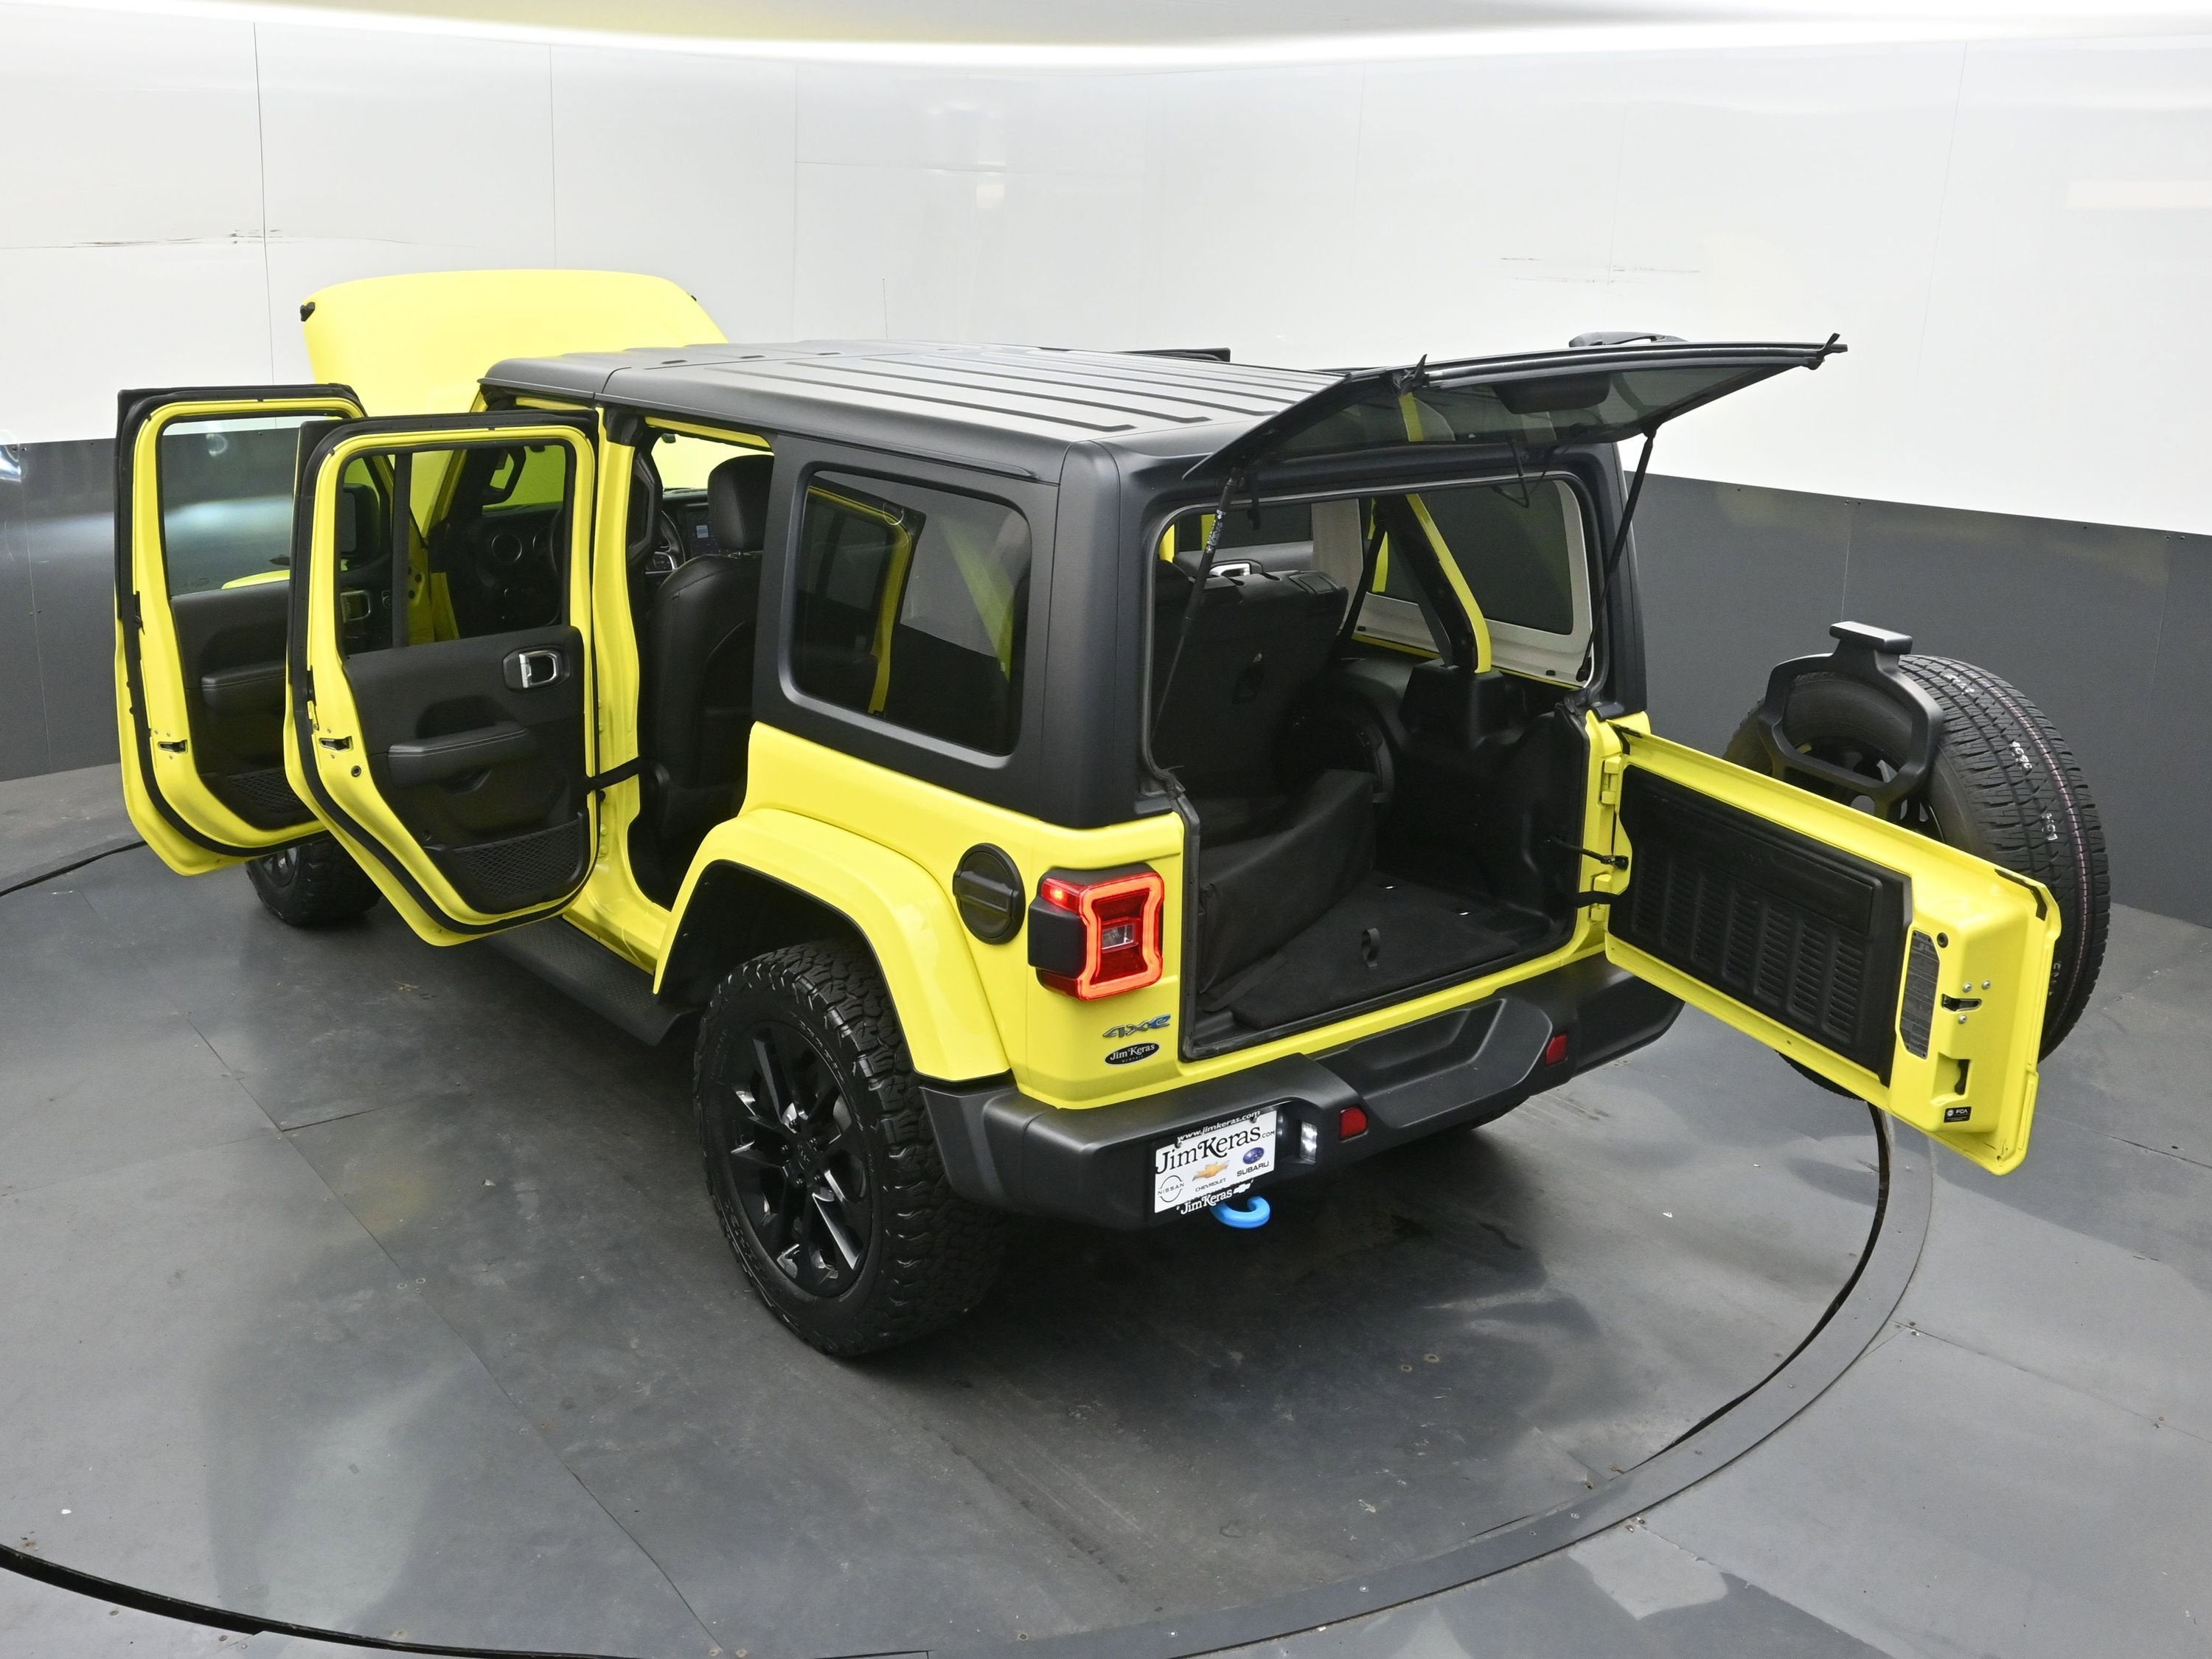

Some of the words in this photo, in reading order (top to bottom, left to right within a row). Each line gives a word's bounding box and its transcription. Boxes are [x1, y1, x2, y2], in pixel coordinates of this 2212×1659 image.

[1237, 1161, 1270, 1177] SUBARU
[1158, 1182, 1185, 1195] NISSAN
[1195, 1178, 1226, 1192] CHEVROLET
